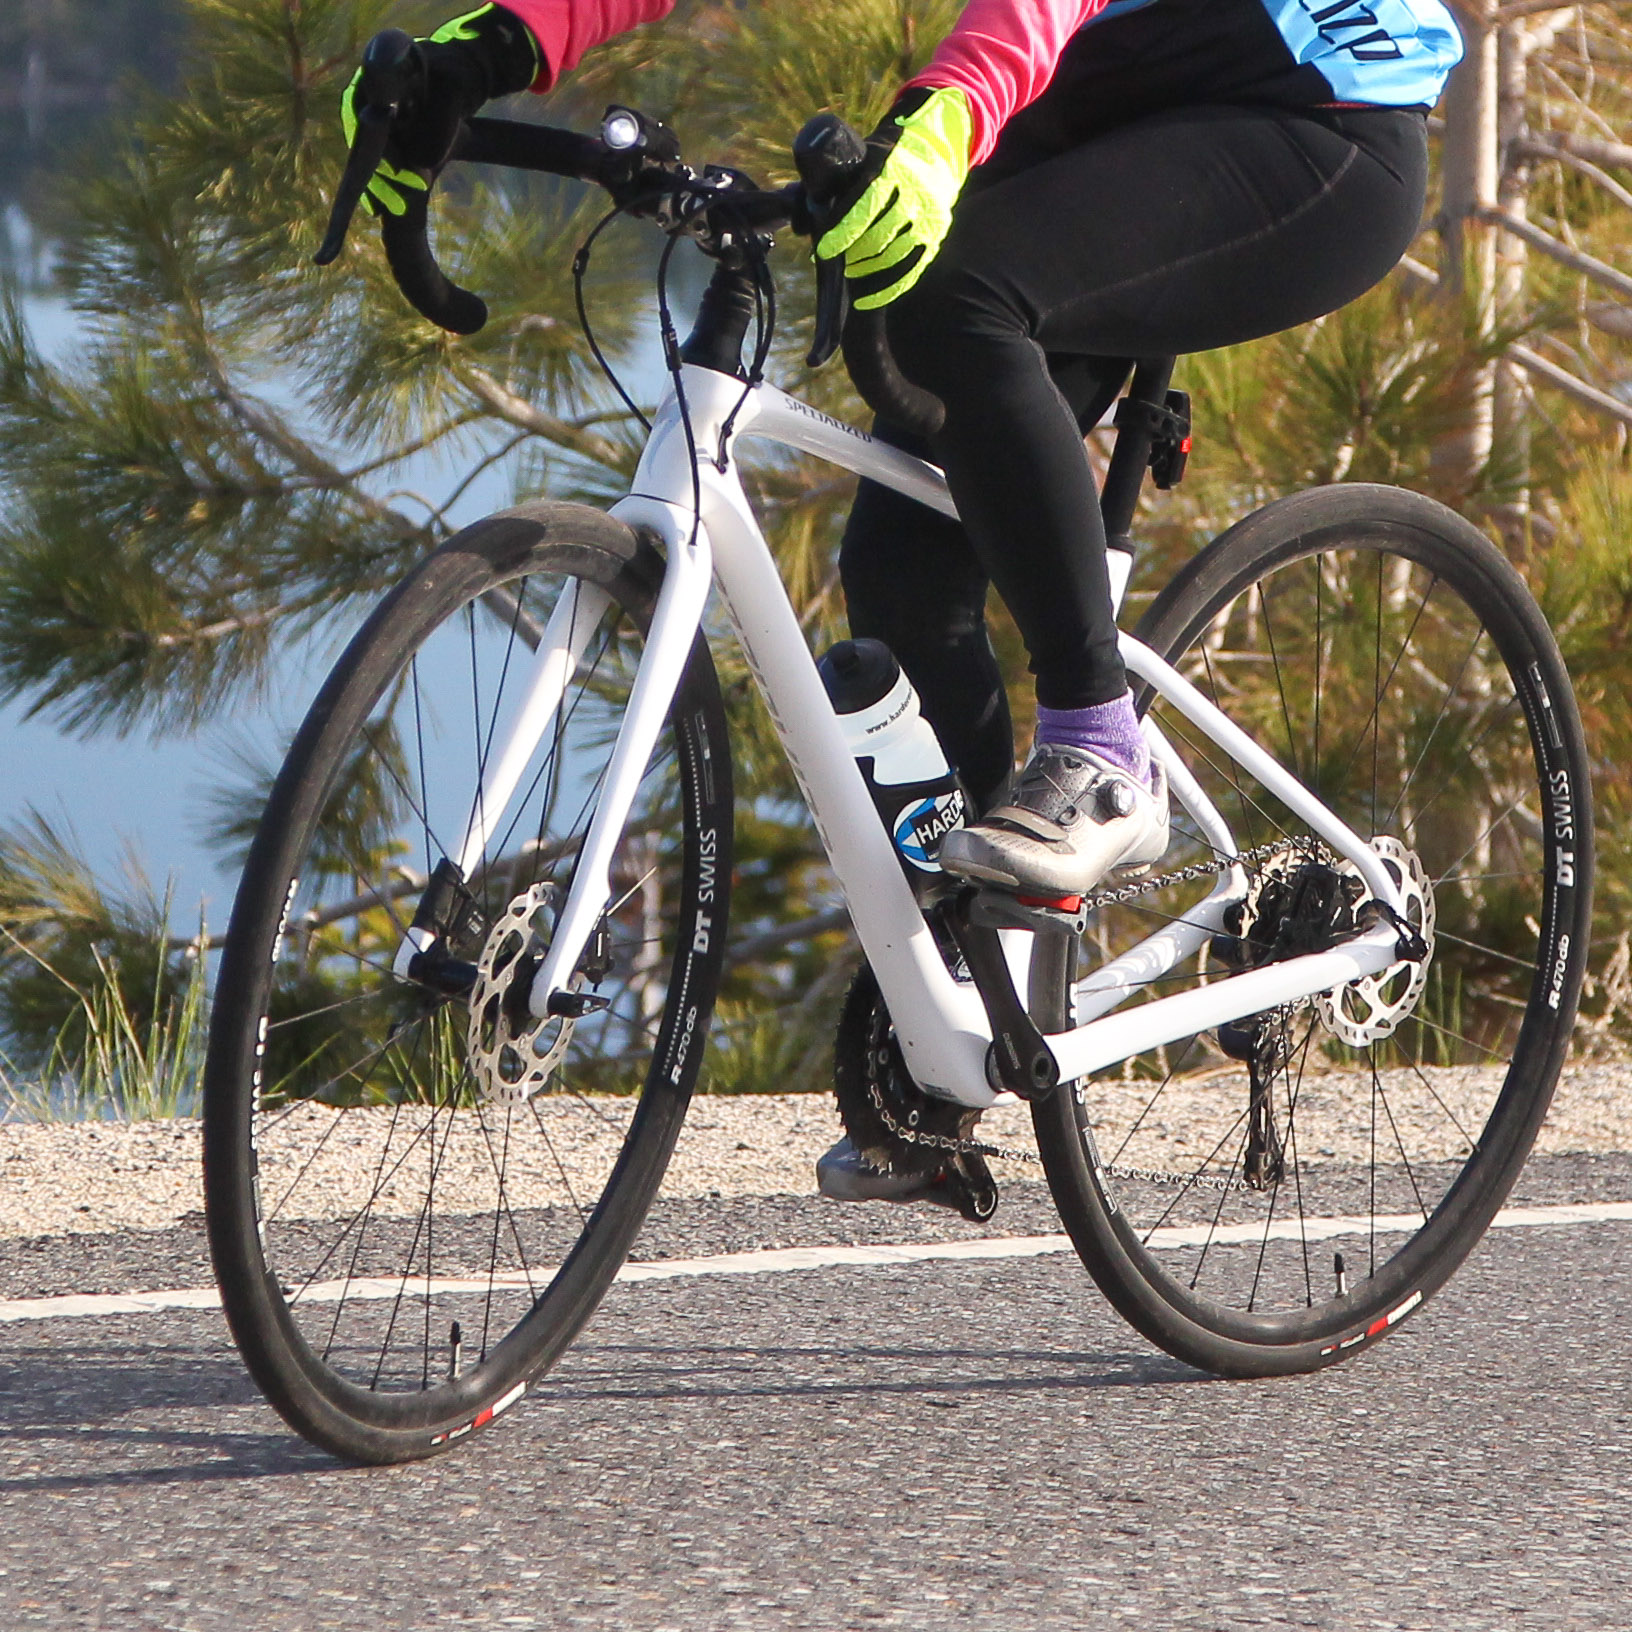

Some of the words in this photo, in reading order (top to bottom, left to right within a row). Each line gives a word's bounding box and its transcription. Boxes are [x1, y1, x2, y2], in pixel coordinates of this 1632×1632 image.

[784, 396, 873, 443] SPECIALIZED
[1549, 769, 1573, 840] SWISS
[698, 827, 716, 903] SWISS
[1556, 846, 1574, 887] DT
[692, 909, 712, 955] DT
